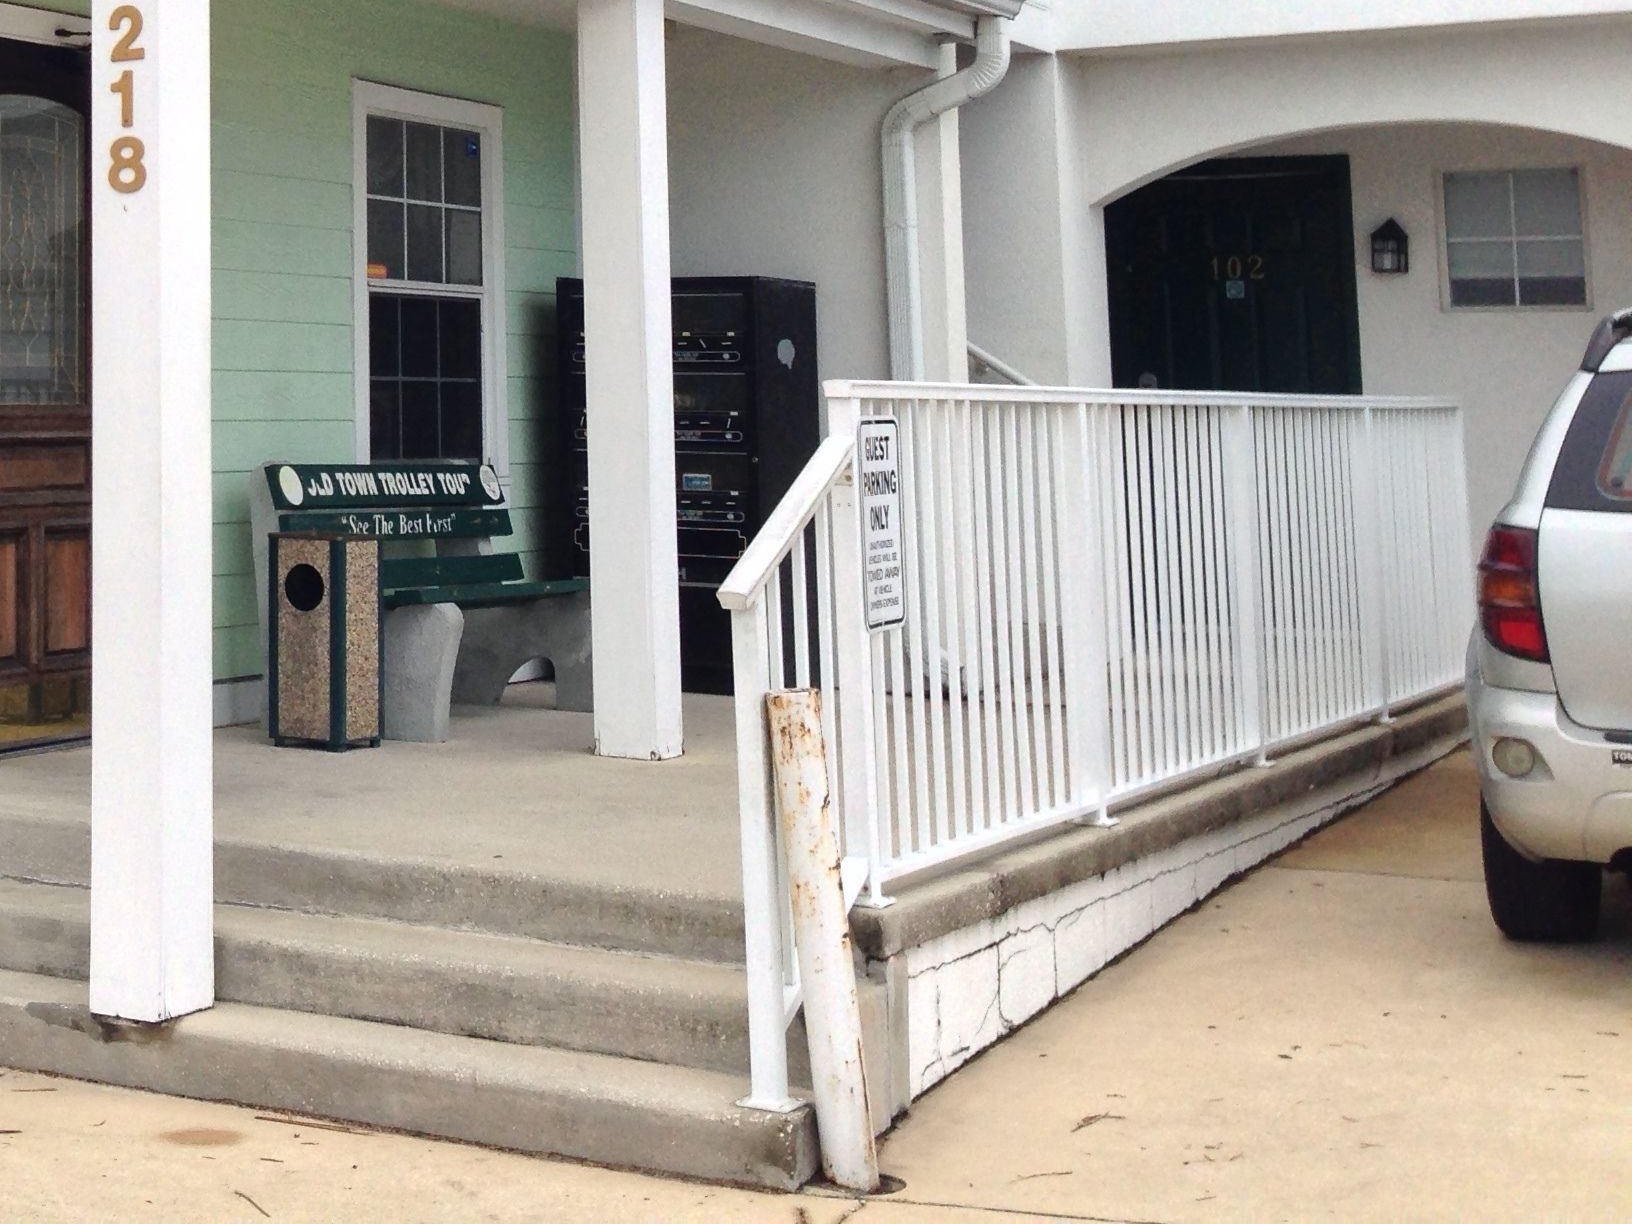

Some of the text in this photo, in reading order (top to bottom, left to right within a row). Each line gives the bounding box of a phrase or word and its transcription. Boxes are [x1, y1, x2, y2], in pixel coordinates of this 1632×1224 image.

[108, 5, 147, 193] 218
[1210, 255, 1265, 280] 102
[865, 436, 889, 461] GUEST
[335, 472, 378, 495] TOWN
[378, 472, 436, 495] TROLLEY
[864, 469, 897, 496] PARKING
[372, 514, 394, 535] The
[399, 514, 423, 535] Best
[870, 505, 889, 531] ONLY
